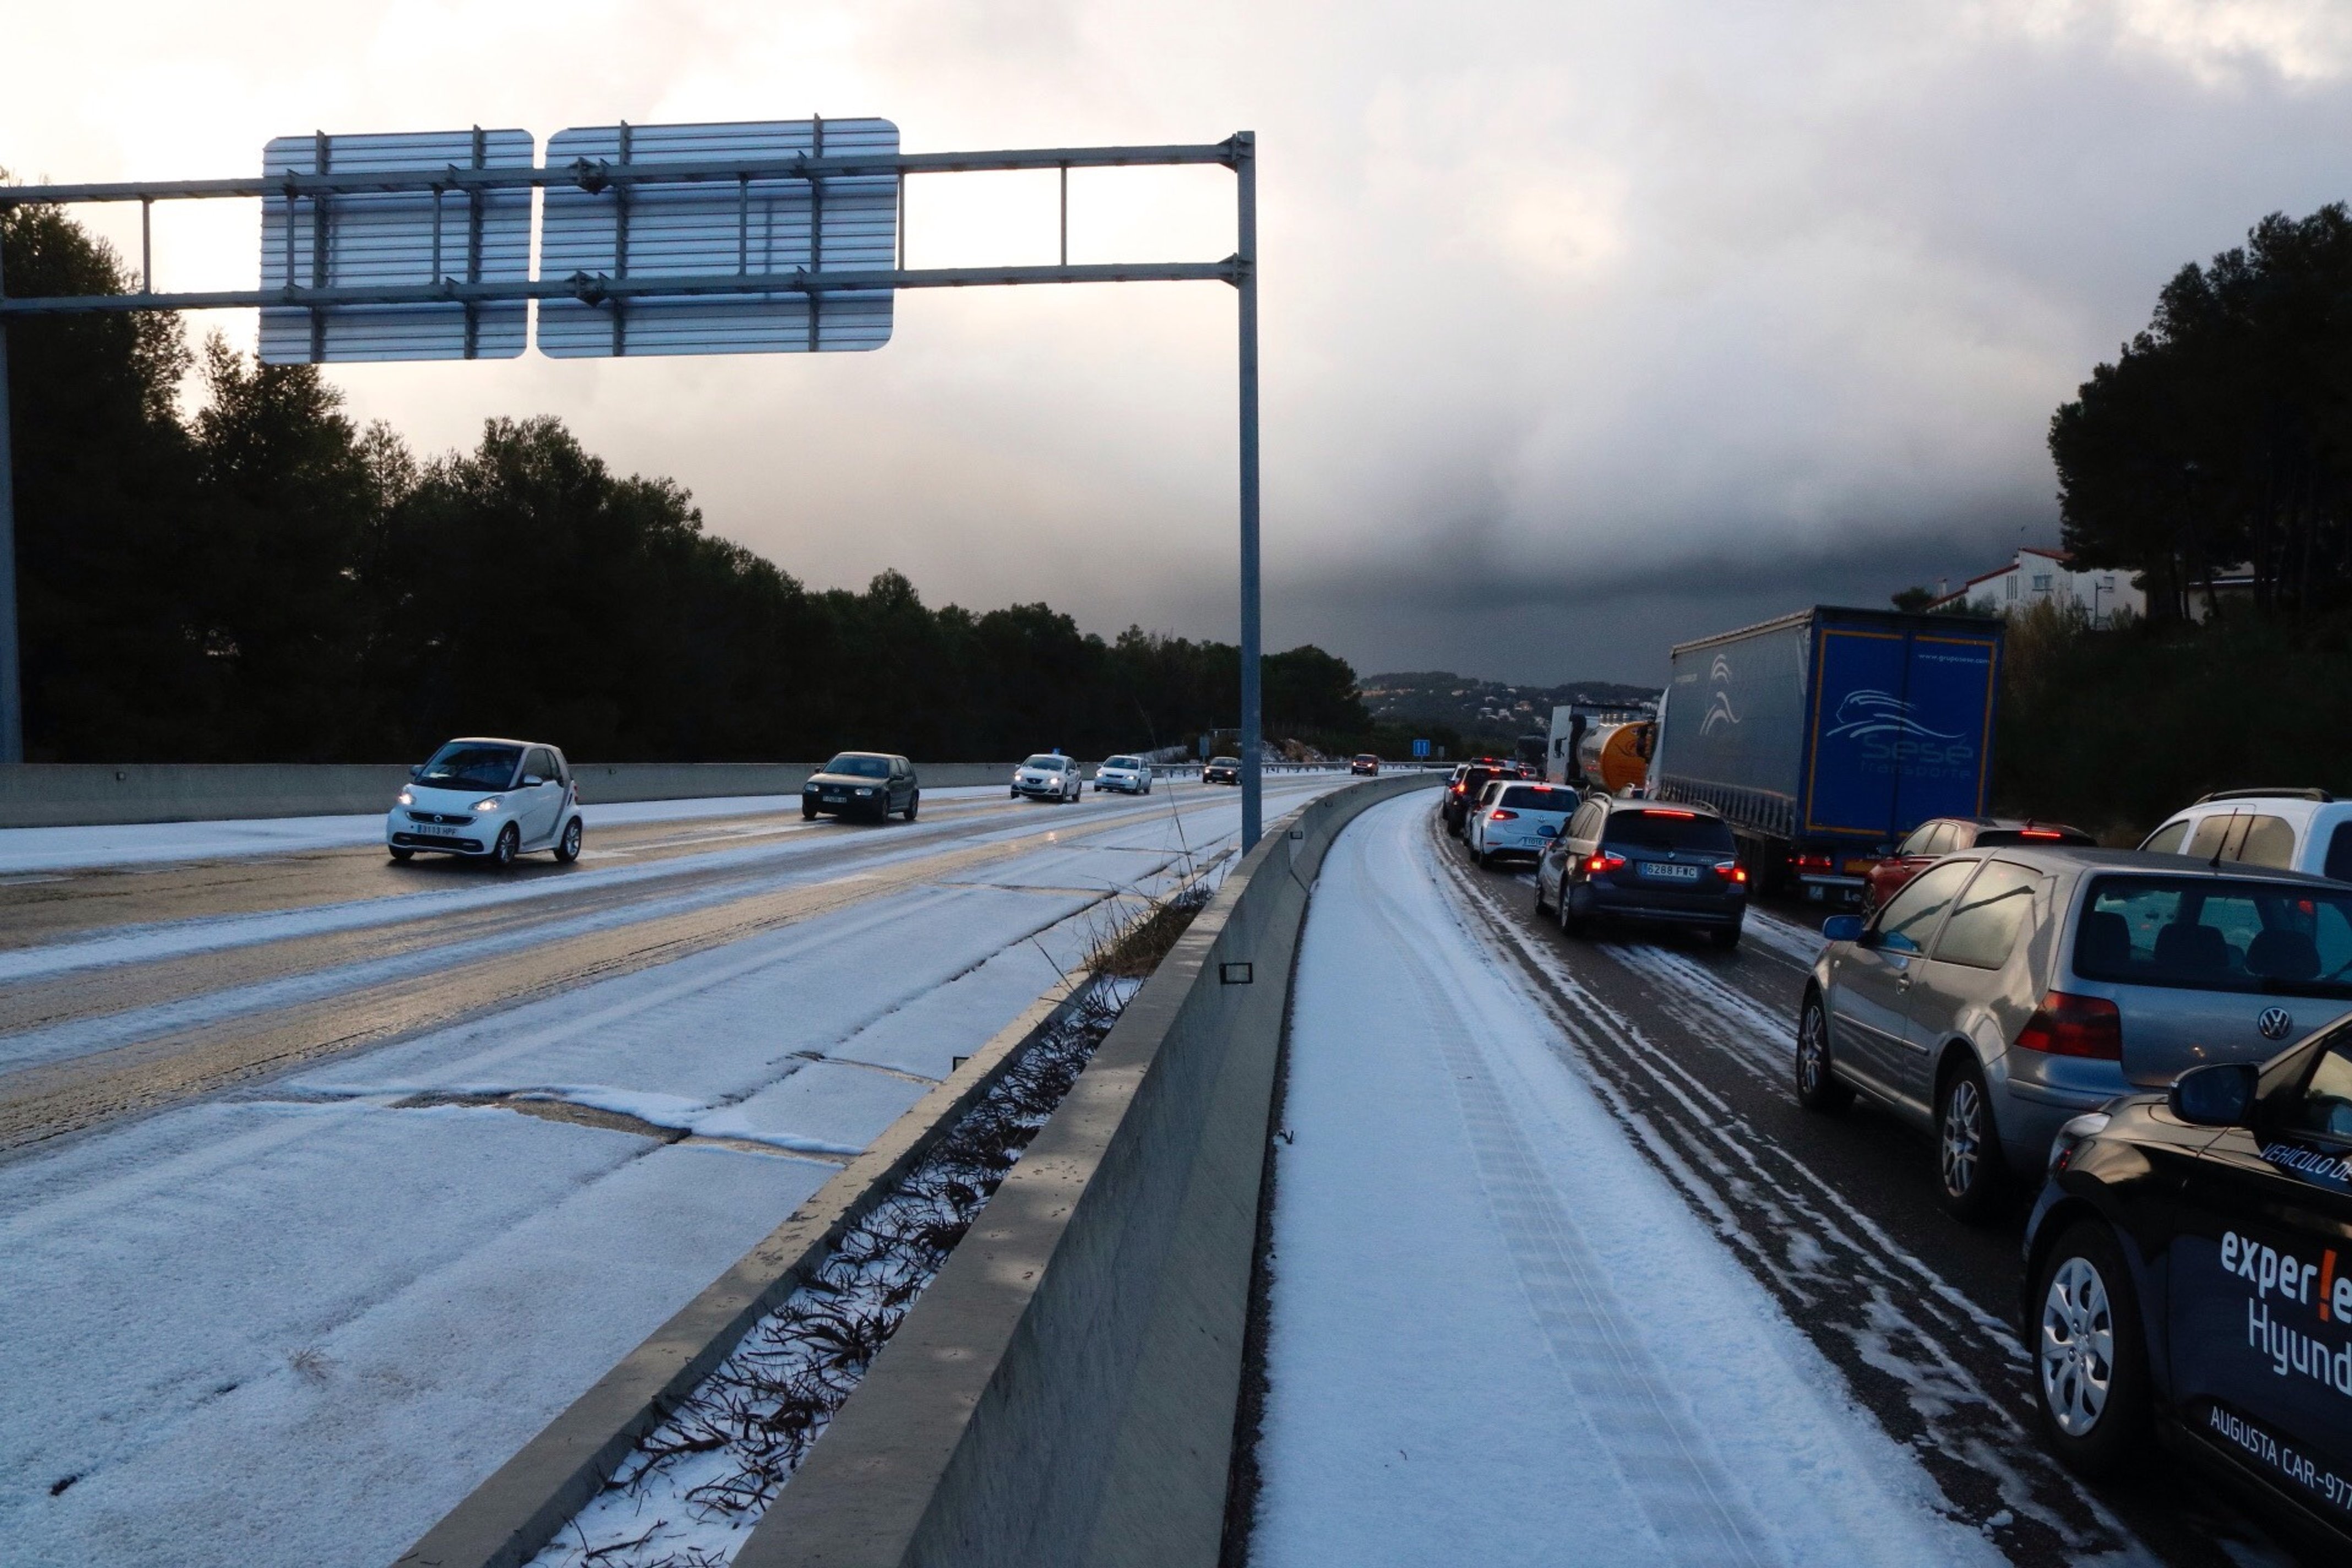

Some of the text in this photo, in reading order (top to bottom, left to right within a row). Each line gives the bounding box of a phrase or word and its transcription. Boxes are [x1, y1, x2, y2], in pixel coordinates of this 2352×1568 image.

[2259, 1142, 2335, 1174] VEHÍCULO
[2248, 1297, 2352, 1397] Hyund
[2211, 1406, 2278, 1466] AUGUSTA
